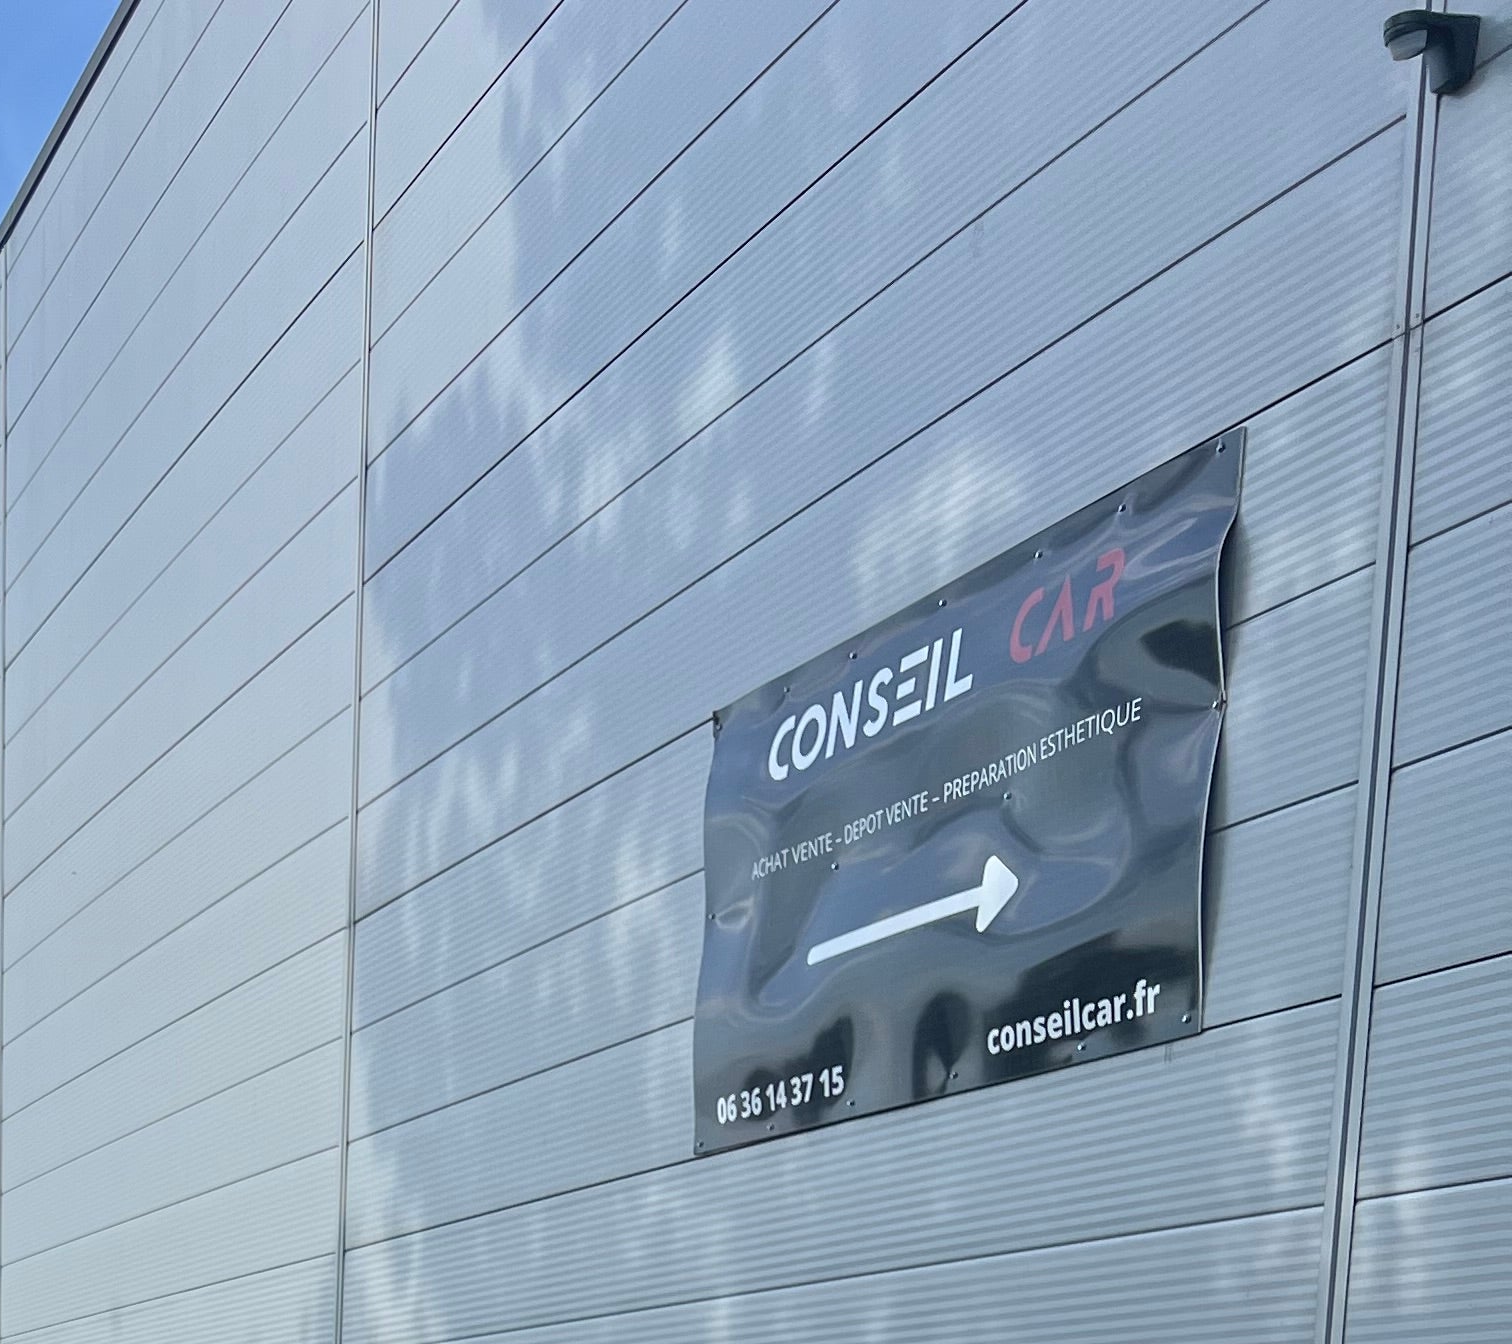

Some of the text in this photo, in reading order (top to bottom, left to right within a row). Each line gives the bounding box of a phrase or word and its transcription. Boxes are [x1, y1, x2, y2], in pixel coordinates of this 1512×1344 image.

[768, 548, 1126, 781] CONSEIL CAR
[751, 849, 790, 880] ACHAT
[791, 832, 833, 864] VENTE
[844, 809, 884, 845] DEPOT
[886, 791, 929, 826] VENTE
[943, 742, 1037, 803] PREPARATION
[1040, 698, 1142, 761] ESTHETIQUE
[987, 978, 1160, 1055] conseilcar.fr
[717, 1065, 845, 1125] 06 36 14 37 15
